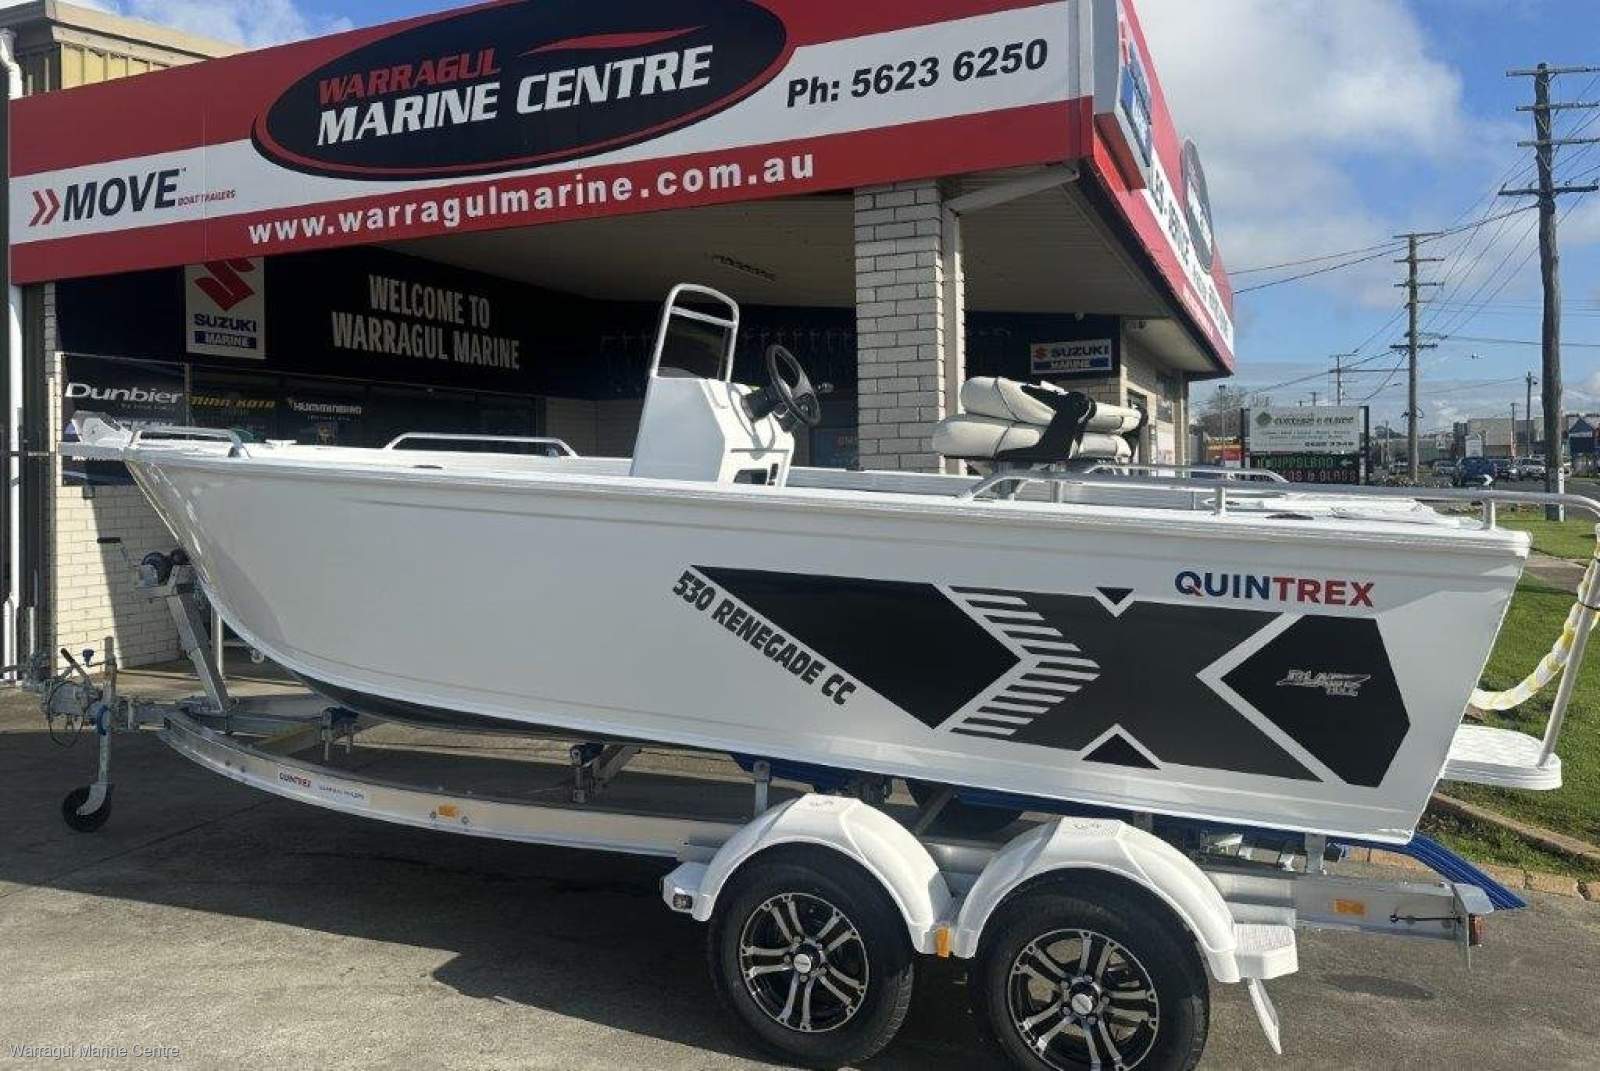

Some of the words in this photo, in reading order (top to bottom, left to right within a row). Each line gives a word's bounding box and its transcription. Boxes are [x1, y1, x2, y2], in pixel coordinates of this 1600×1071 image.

[317, 82, 500, 146] MARINE
[516, 45, 714, 115] CENTRE
[319, 48, 500, 104] WARRAGUL
[787, 76, 840, 108] Ph:
[851, 57, 939, 98] 5623
[953, 38, 1048, 82] 6250
[62, 168, 181, 222] MOVE
[248, 153, 814, 244] www.warragulmarine.com.au
[193, 313, 257, 332] SUZUKI
[369, 274, 465, 325] WELCOME
[468, 294, 490, 329] TO
[208, 332, 249, 349] MARINE
[331, 311, 448, 360] WARRAGUL
[453, 330, 520, 370] MARINE
[1051, 344, 1110, 358] SUZUKI
[65, 382, 184, 404] Dunbier
[1174, 570, 1375, 607] QUINTREX
[672, 570, 717, 611] 530
[711, 597, 826, 686] RENEGADE
[821, 673, 857, 705] CC
